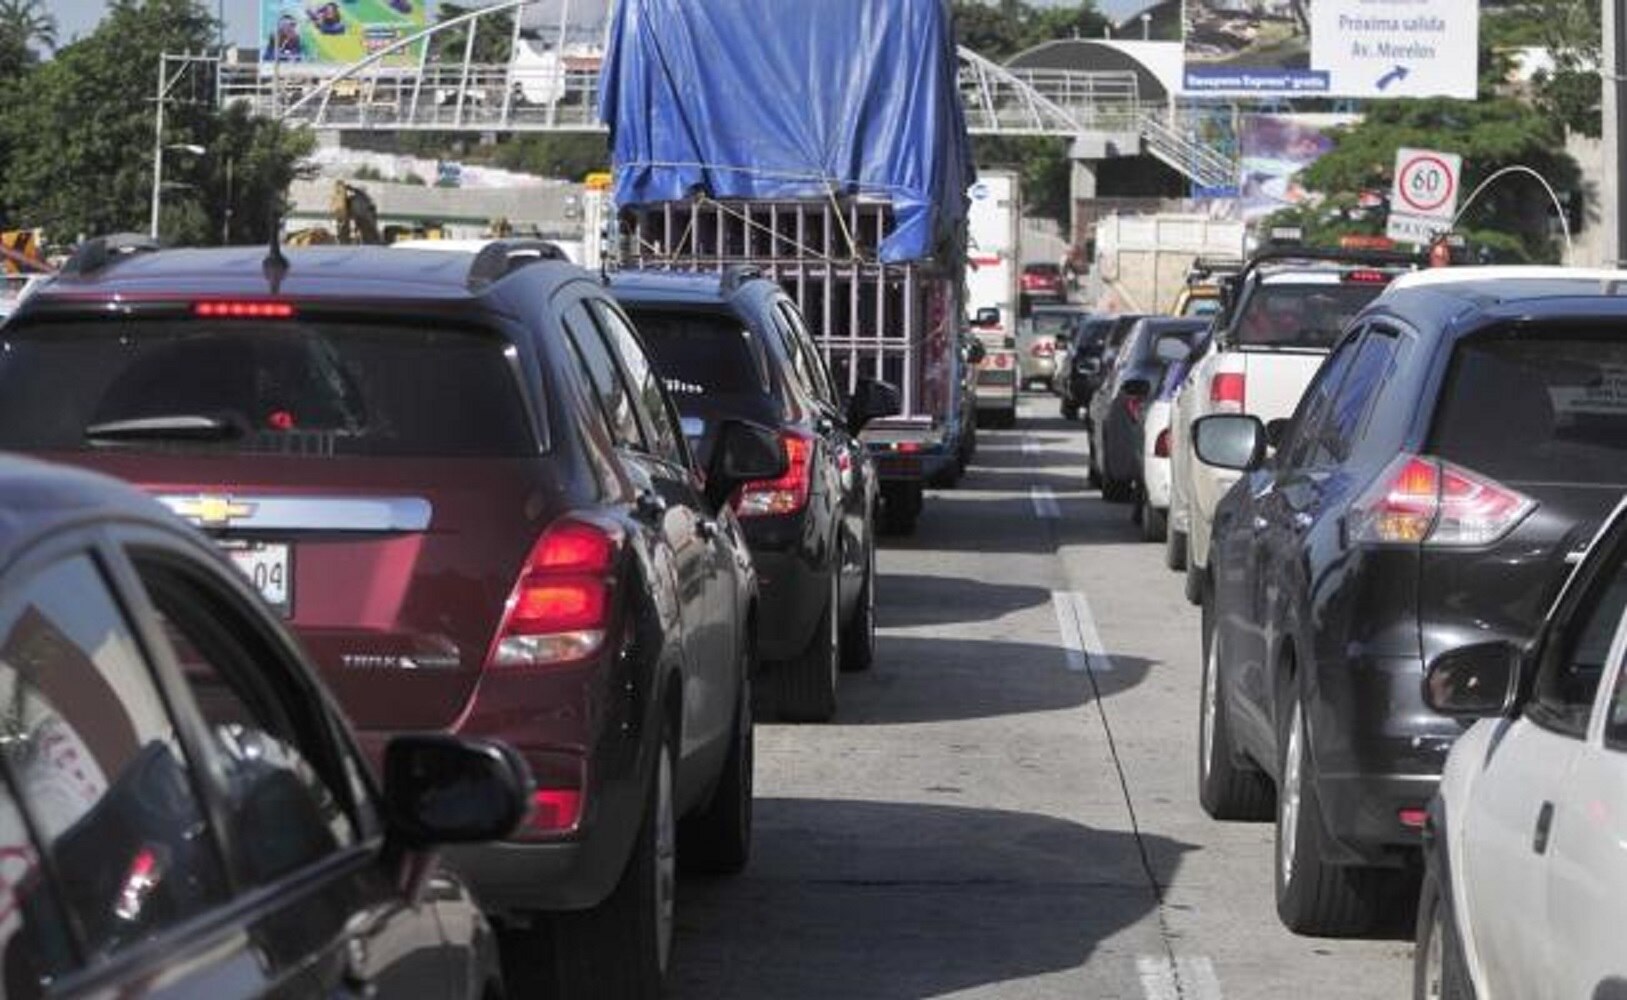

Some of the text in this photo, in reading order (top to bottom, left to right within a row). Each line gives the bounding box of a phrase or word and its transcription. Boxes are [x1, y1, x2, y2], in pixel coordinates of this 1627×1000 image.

[1402, 14, 1446, 31] salida
[1377, 40, 1436, 58] Morelos
[1411, 167, 1440, 192] 60
